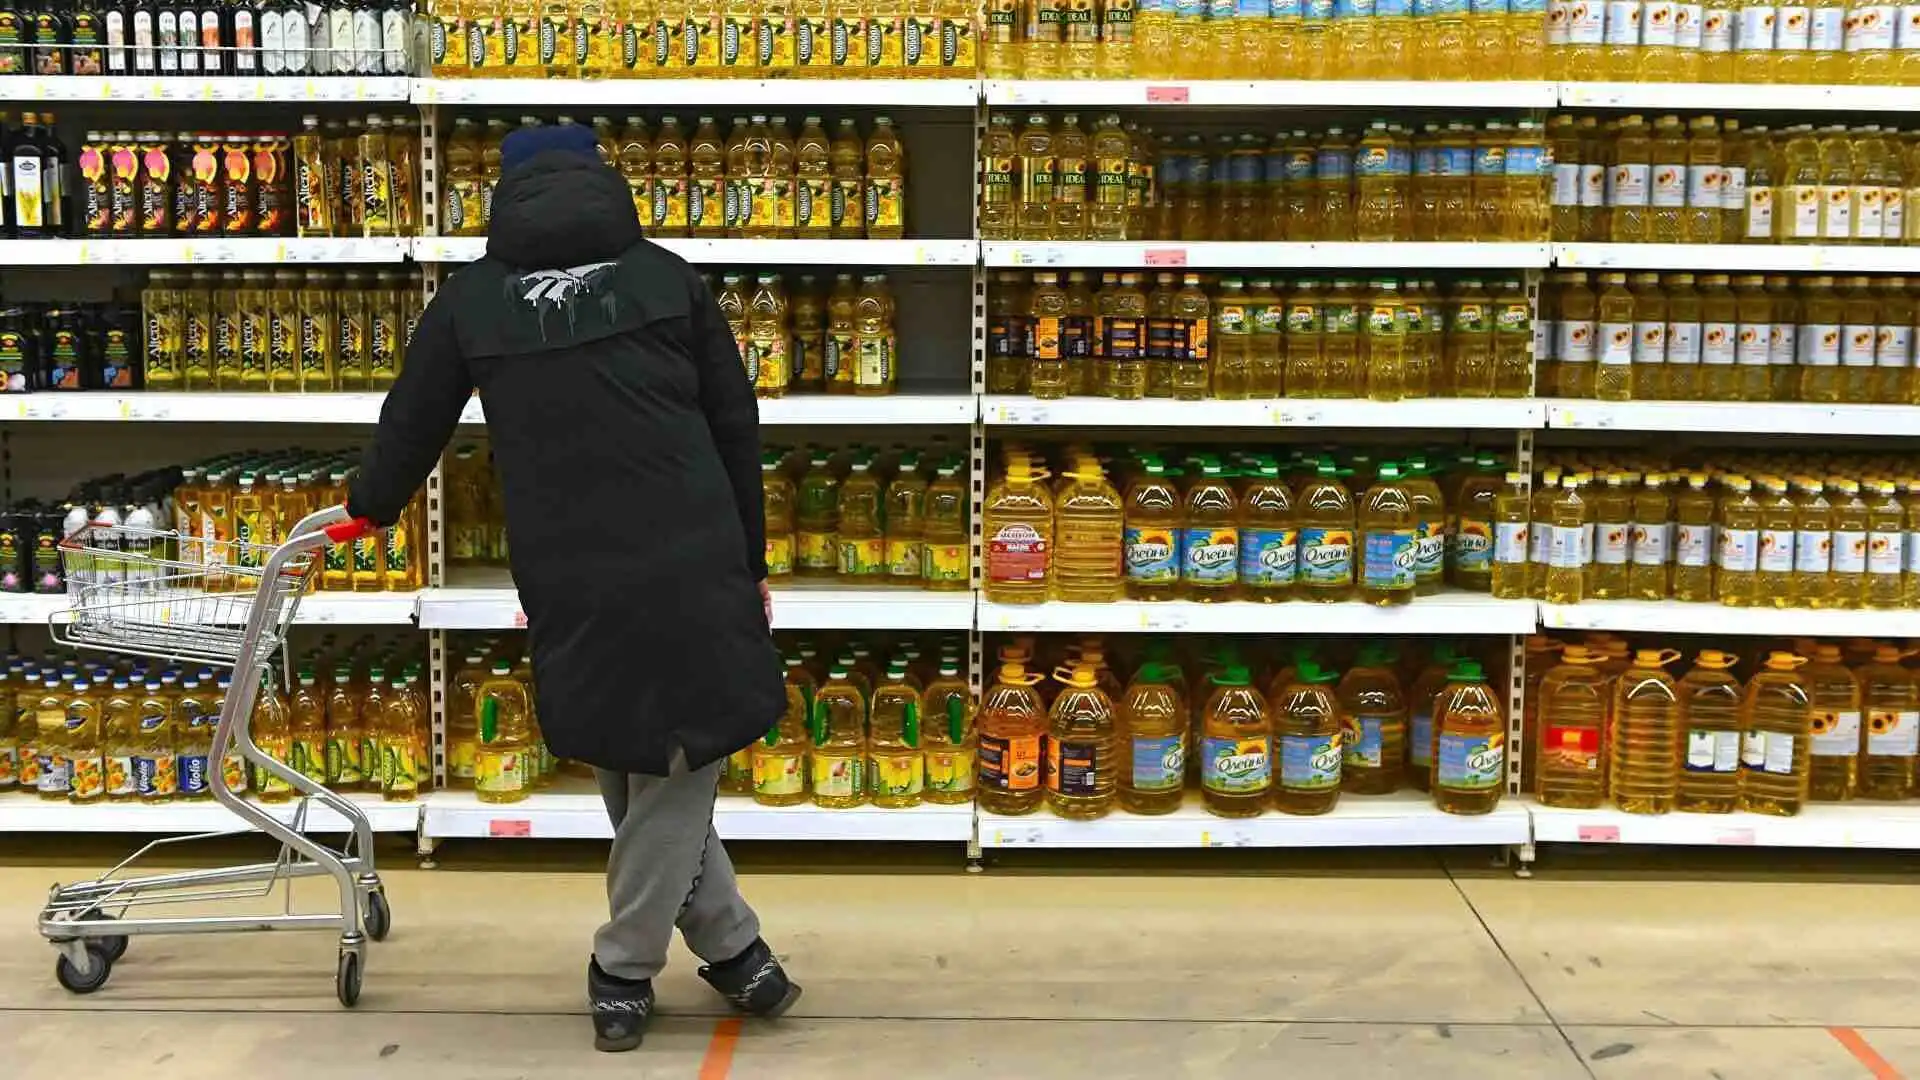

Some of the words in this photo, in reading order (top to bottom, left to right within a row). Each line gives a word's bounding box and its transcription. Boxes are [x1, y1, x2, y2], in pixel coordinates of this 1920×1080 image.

[299, 164, 312, 207] Altero
[364, 164, 377, 207] Altero
[189, 759, 200, 790] Violio
